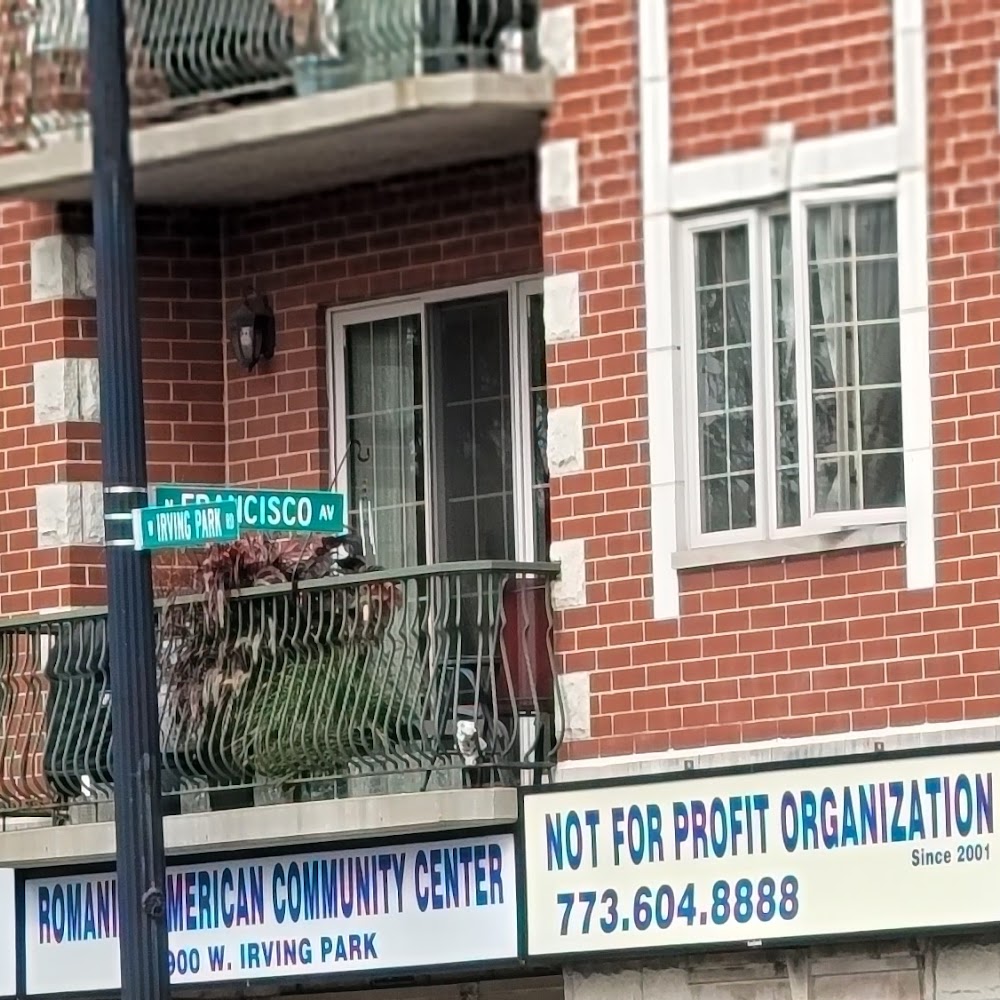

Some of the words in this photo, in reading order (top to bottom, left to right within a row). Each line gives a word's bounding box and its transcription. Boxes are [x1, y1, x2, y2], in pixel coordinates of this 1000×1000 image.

[156, 510, 191, 542] IRVING
[194, 508, 222, 539] PARK
[181, 493, 312, 527] CISCO
[319, 504, 335, 521] AV
[546, 810, 600, 871] NOT
[611, 803, 665, 866] FOR
[673, 793, 770, 861] PROFIT
[781, 772, 994, 852] ORGANIZATION
[911, 848, 951, 867] Since
[957, 843, 989, 863] 2001
[38, 880, 118, 944] ROMANI
[167, 864, 264, 932] MERICAN
[272, 853, 406, 925] COMMUNITY
[414, 843, 504, 912] CENTER
[557, 875, 800, 936] 773.604.8888
[168, 948, 200, 976] 900
[207, 944, 232, 972] W.
[240, 937, 312, 969] IRVING
[320, 932, 378, 963] PARK
